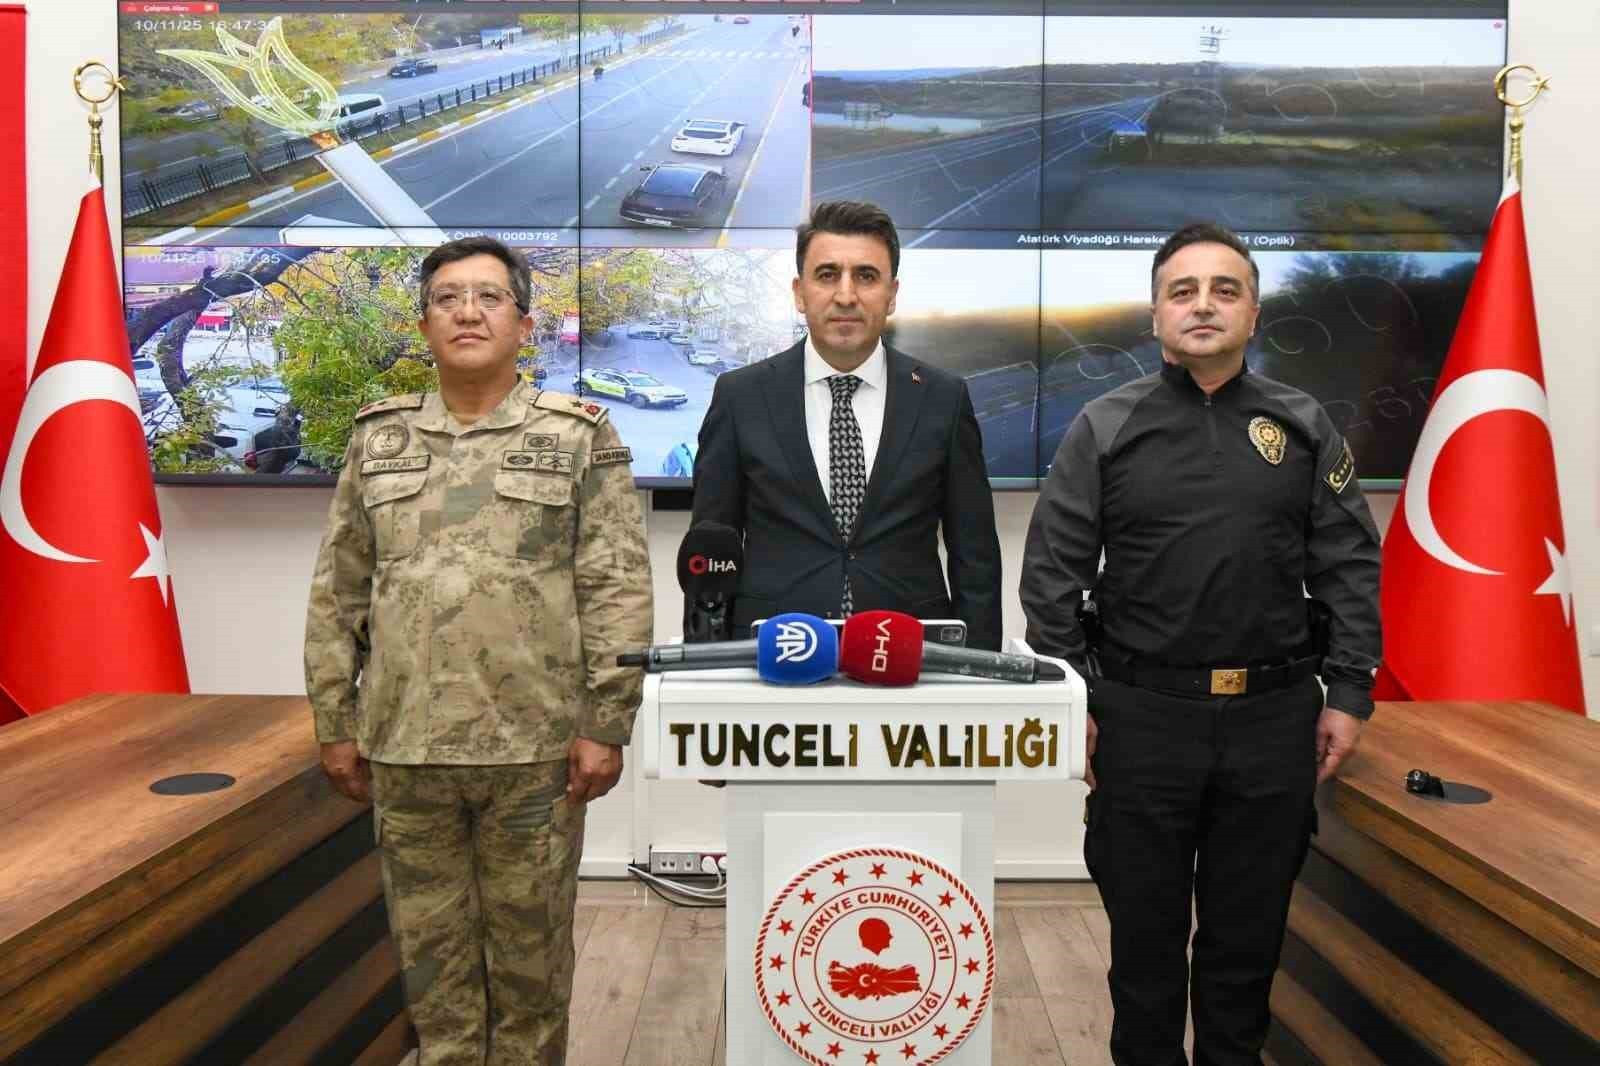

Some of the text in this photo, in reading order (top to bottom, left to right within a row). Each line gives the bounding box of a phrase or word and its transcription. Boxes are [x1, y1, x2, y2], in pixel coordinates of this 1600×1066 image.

[134, 20, 202, 32] 10/11/25
[495, 231, 559, 241] 10003792
[1017, 233, 1060, 244] Atatürk
[1063, 233, 1120, 246] Viyadüğü
[1123, 234, 1170, 244] Hareke
[1253, 234, 1296, 247] (Optik)
[669, 717, 1059, 768] TUNCELİ VALİLİĞİ
[800, 891, 953, 961] TÜRKİYE CUMHURİYETİ
[812, 991, 942, 1038] TUNCELİ VALİLİĞİ
